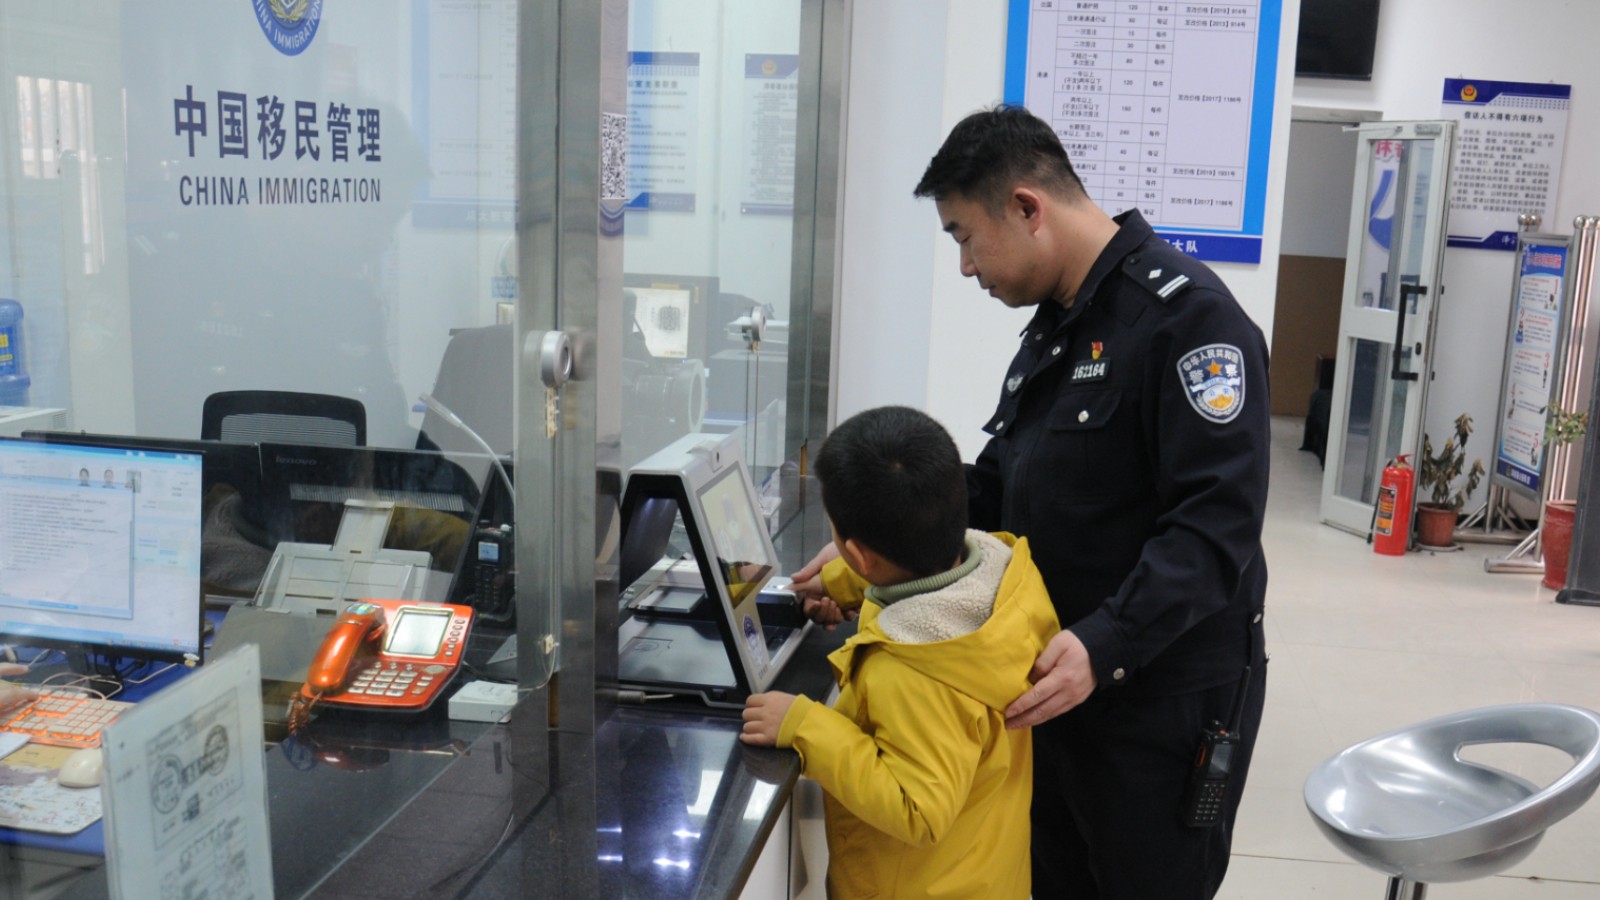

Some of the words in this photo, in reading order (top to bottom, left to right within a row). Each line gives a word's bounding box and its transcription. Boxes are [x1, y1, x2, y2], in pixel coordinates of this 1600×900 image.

[173, 85, 382, 164] 中国移民管理
[1464, 111, 1544, 124] 信访人不得有六项行为
[179, 175, 250, 206] CHINA
[258, 177, 382, 206] IMMIGRATION
[1165, 239, 1198, 253] 大队
[1182, 348, 1239, 372] 中华人民共和国
[1189, 363, 1238, 384] 警察
[275, 455, 318, 466] lenovo
